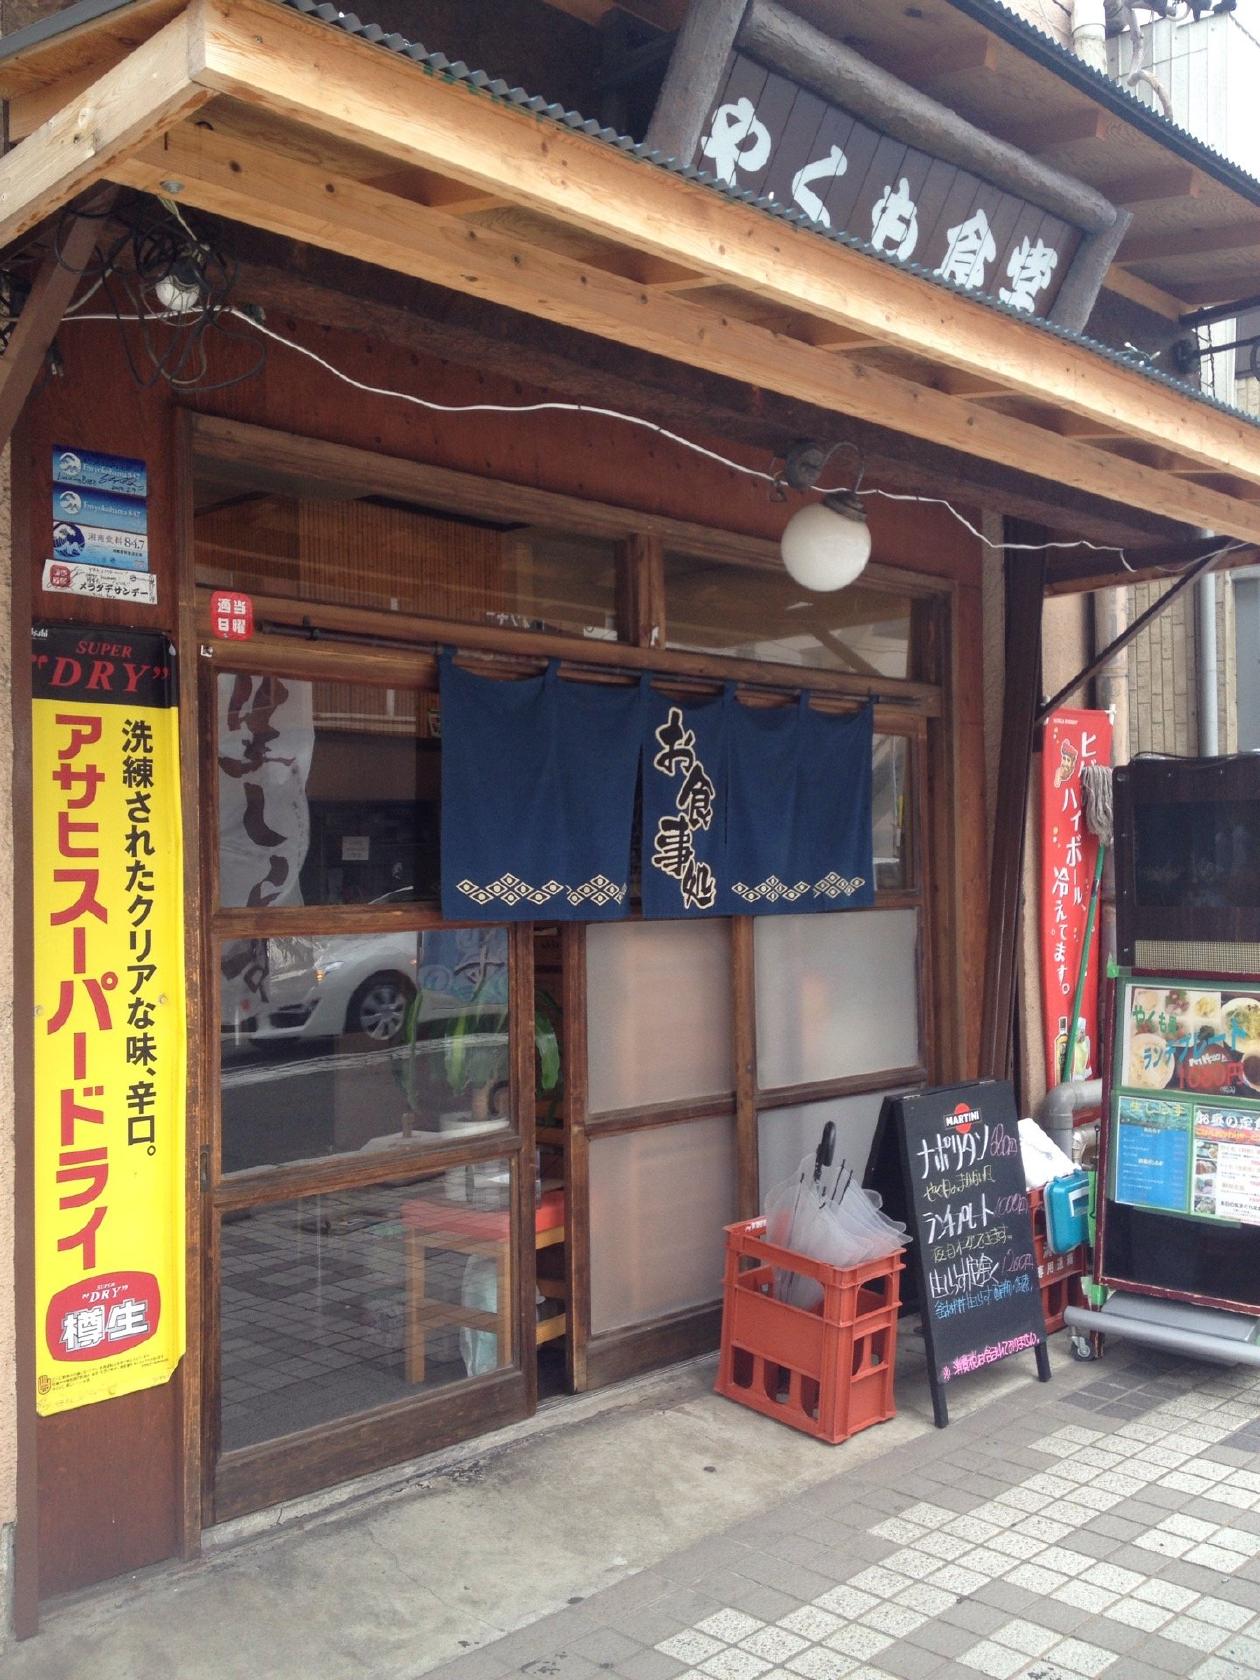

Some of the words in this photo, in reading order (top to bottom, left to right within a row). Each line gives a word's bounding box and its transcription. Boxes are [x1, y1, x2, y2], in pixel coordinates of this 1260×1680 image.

[701, 97, 1058, 313] やくも食堂
[76, 640, 133, 658] SUPER
[652, 707, 716, 909] お食事処
[47, 714, 118, 1270] アサヒスーパードライ
[121, 719, 157, 1157] 洗練されたクリアな味、辛口。
[917, 1124, 989, 1179] ナポリタン
[945, 1110, 980, 1127] MARTINI
[60, 1299, 150, 1352] 樽生
